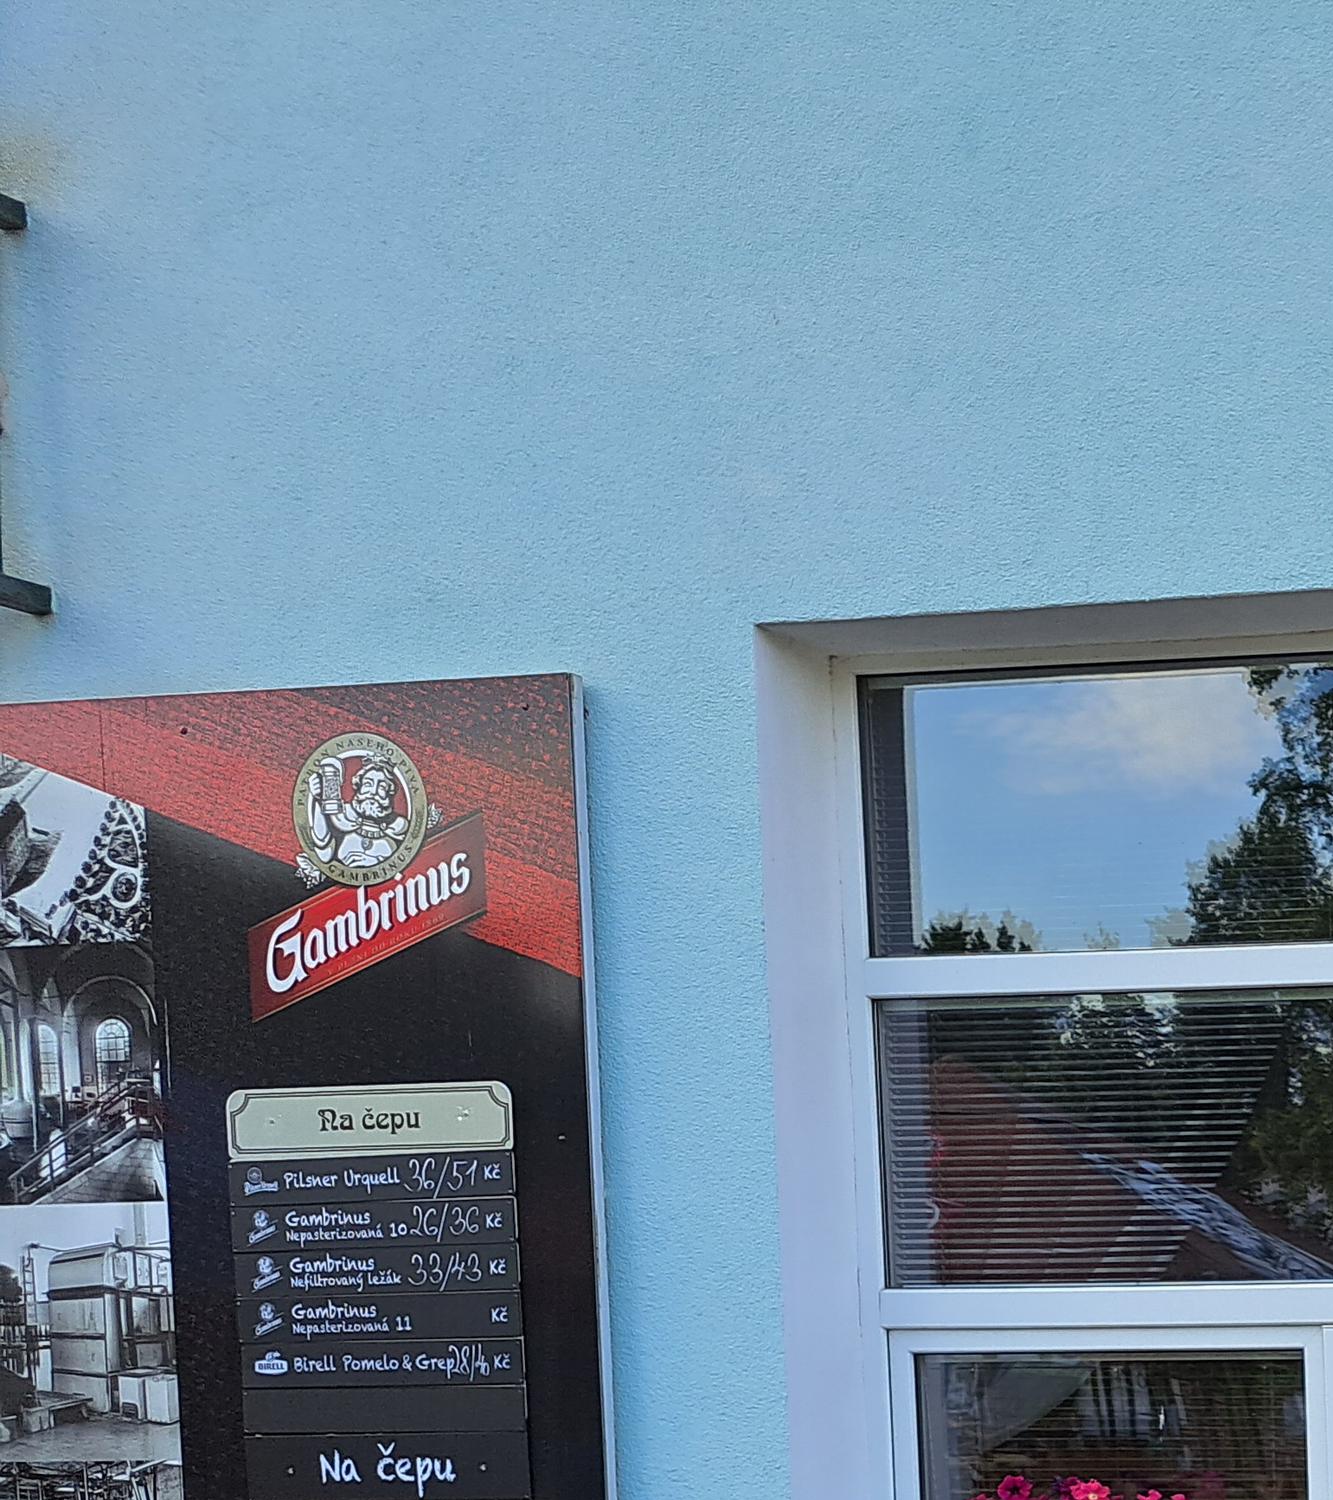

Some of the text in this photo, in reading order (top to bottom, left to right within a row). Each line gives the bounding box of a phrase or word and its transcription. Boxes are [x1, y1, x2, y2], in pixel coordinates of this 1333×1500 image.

[328, 844, 413, 882] GAMBRINUS
[266, 853, 471, 993] Gambrinus
[318, 1106, 421, 1134] Na čepu
[283, 1169, 338, 1189] Pilsner
[343, 1166, 401, 1194] Urquell
[403, 1156, 501, 1199] 36/51 Kč
[285, 1207, 371, 1227] Gambrinus
[409, 1203, 503, 1242] 26/36 Kč
[286, 1223, 384, 1248] Nepasterizovaná
[389, 1222, 407, 1236] 10
[289, 1253, 375, 1273] Gambrinus
[407, 1252, 507, 1291] 33/43 Kč
[290, 1272, 364, 1292] Nefiltrovaný
[367, 1269, 402, 1285] ležák
[291, 1300, 377, 1319] Gambrinus
[491, 1307, 509, 1323] Kč
[292, 1318, 390, 1340] Nepasterizovaná
[395, 1316, 412, 1331] 11
[258, 1363, 285, 1371] BIRELL
[293, 1355, 337, 1372] Birell
[342, 1356, 399, 1372] Pomelo
[402, 1356, 412, 1371] &
[494, 1353, 511, 1369] Kč
[319, 1441, 457, 1498] Na čepu
